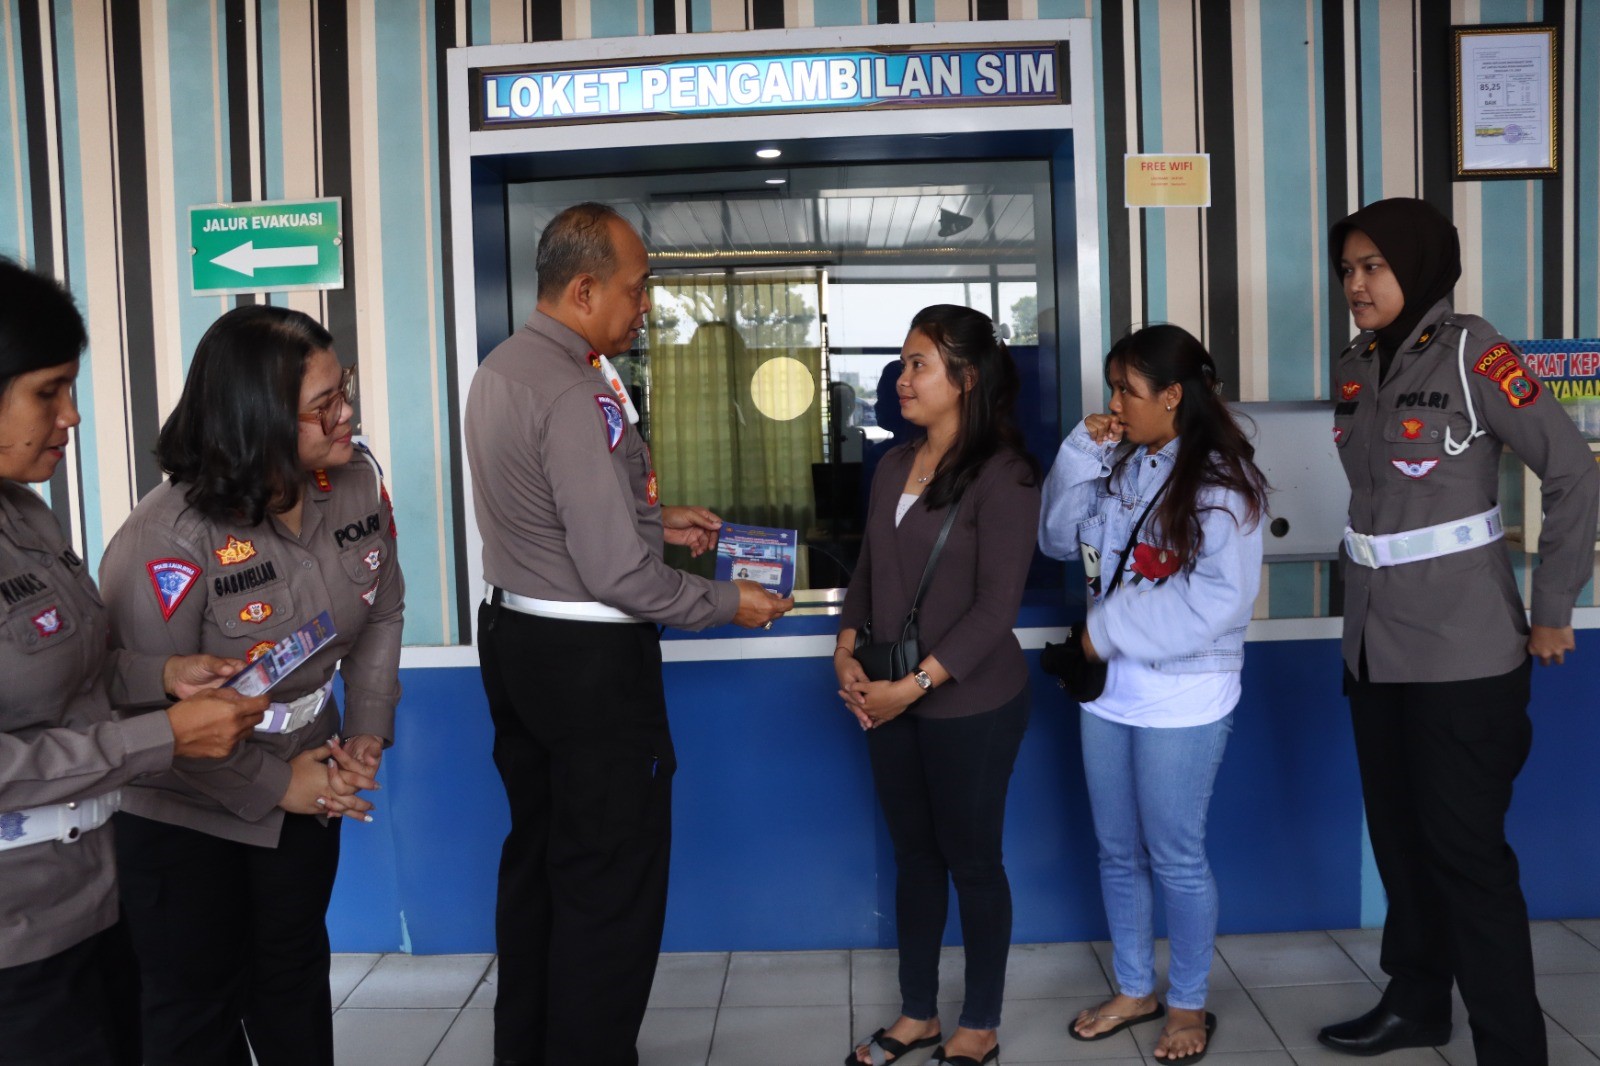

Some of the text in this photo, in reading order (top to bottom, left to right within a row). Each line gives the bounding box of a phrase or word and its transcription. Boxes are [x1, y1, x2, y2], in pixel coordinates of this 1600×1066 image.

[485, 52, 1055, 119] LOKET PENGAMBILAN SIM
[1140, 161, 1193, 171] FREE WIFI
[202, 212, 323, 233] JALUR EVAKUASI
[1478, 346, 1508, 372] POLDA
[1545, 380, 1600, 399] YANA
[1395, 391, 1449, 410] POLRI
[334, 513, 380, 548] POLRI
